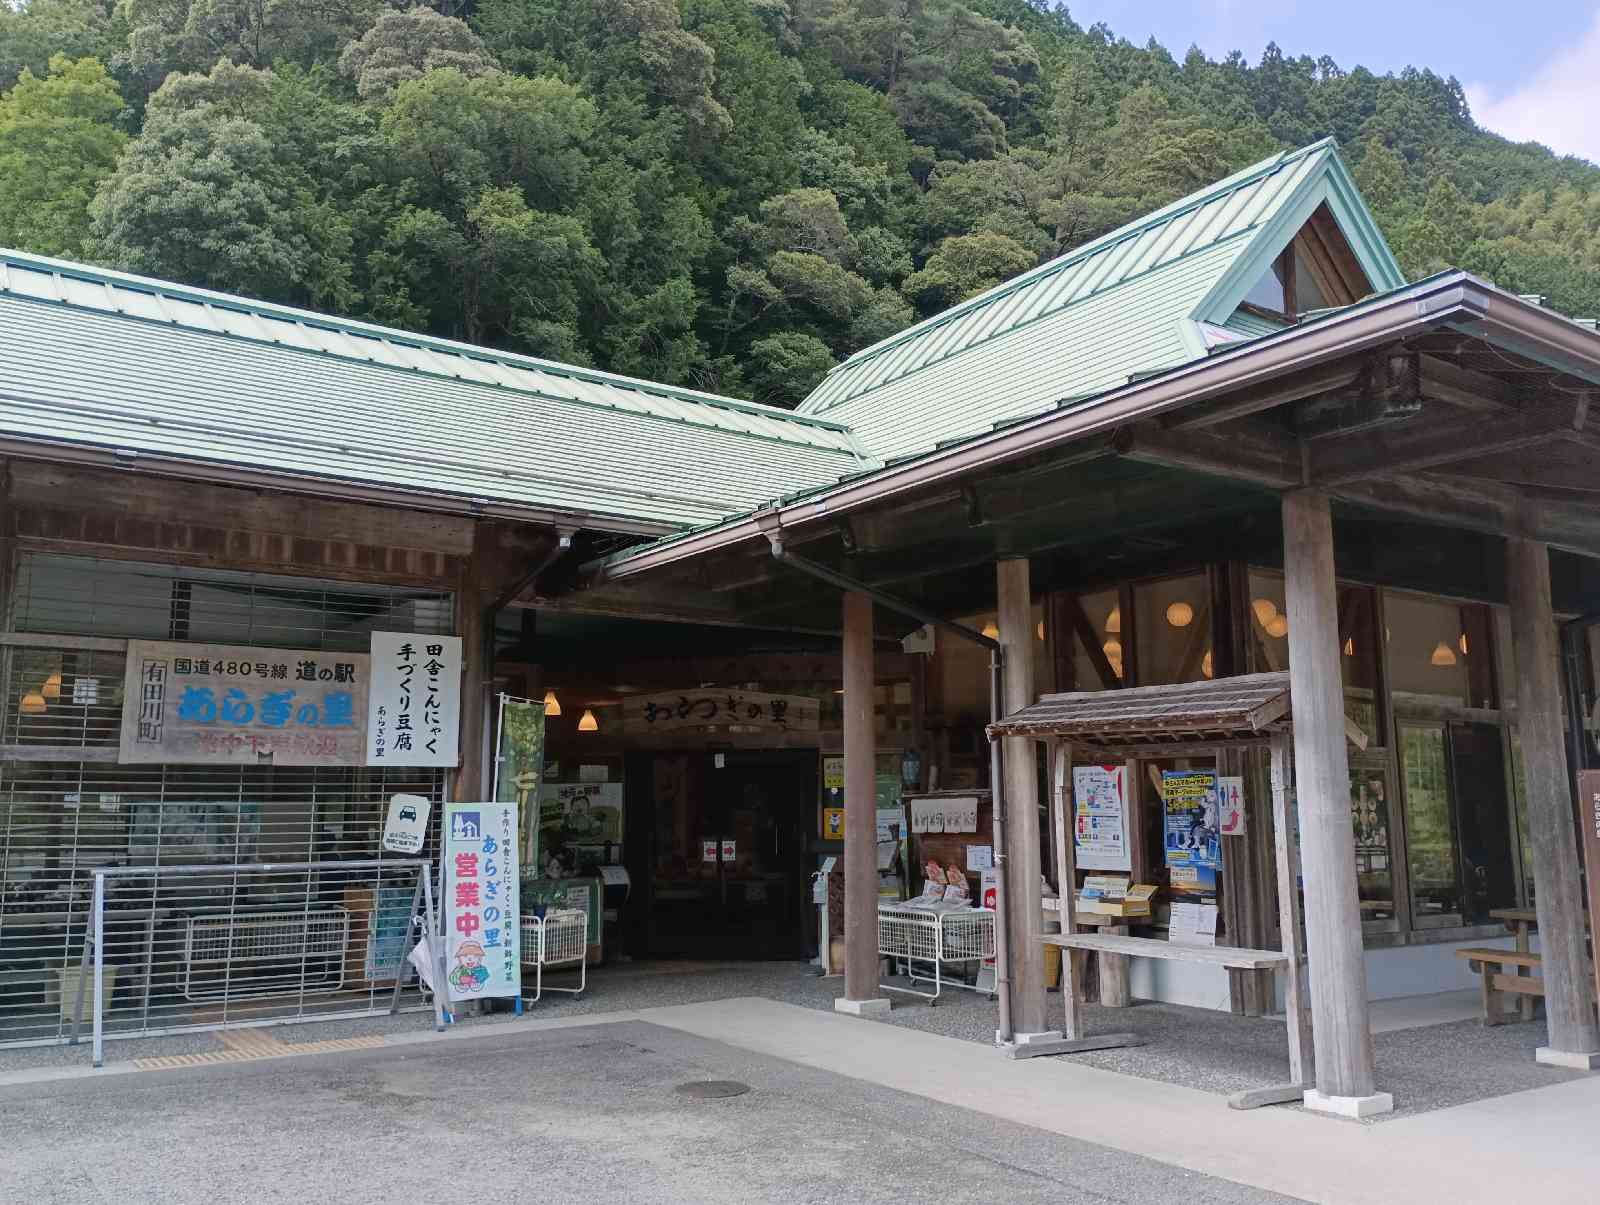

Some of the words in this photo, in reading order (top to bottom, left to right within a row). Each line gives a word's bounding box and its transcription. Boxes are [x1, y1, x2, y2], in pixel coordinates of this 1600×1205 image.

[140, 663, 165, 741] 有田川町
[174, 658, 288, 679] 国道480号線
[296, 660, 356, 683] 道の駅
[178, 685, 353, 726] あらぎの里
[393, 643, 418, 752] 手づくり豆腐
[423, 643, 446, 755] 田舎こんにゃく
[375, 706, 386, 757] あらぎの里
[455, 853, 480, 936] 営業中
[482, 835, 502, 948] あらぎの里
